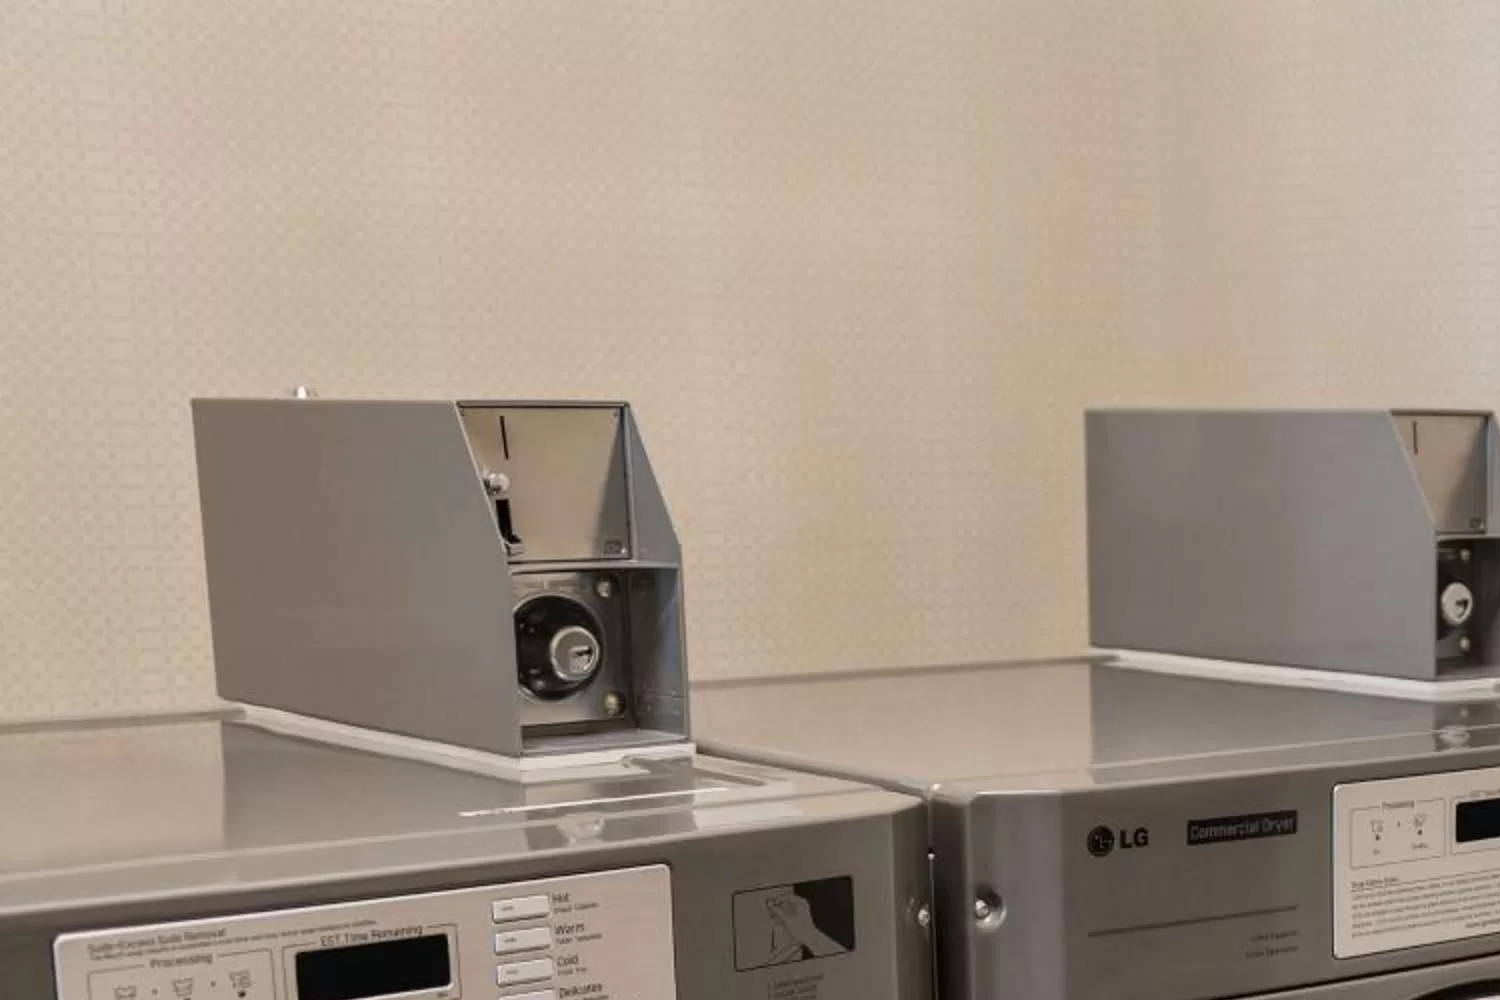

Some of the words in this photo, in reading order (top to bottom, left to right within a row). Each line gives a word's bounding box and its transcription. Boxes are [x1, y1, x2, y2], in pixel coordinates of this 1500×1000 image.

[1119, 827, 1149, 849] LG
[1190, 820, 1259, 840] Commercial
[1262, 816, 1294, 833] Dryer
